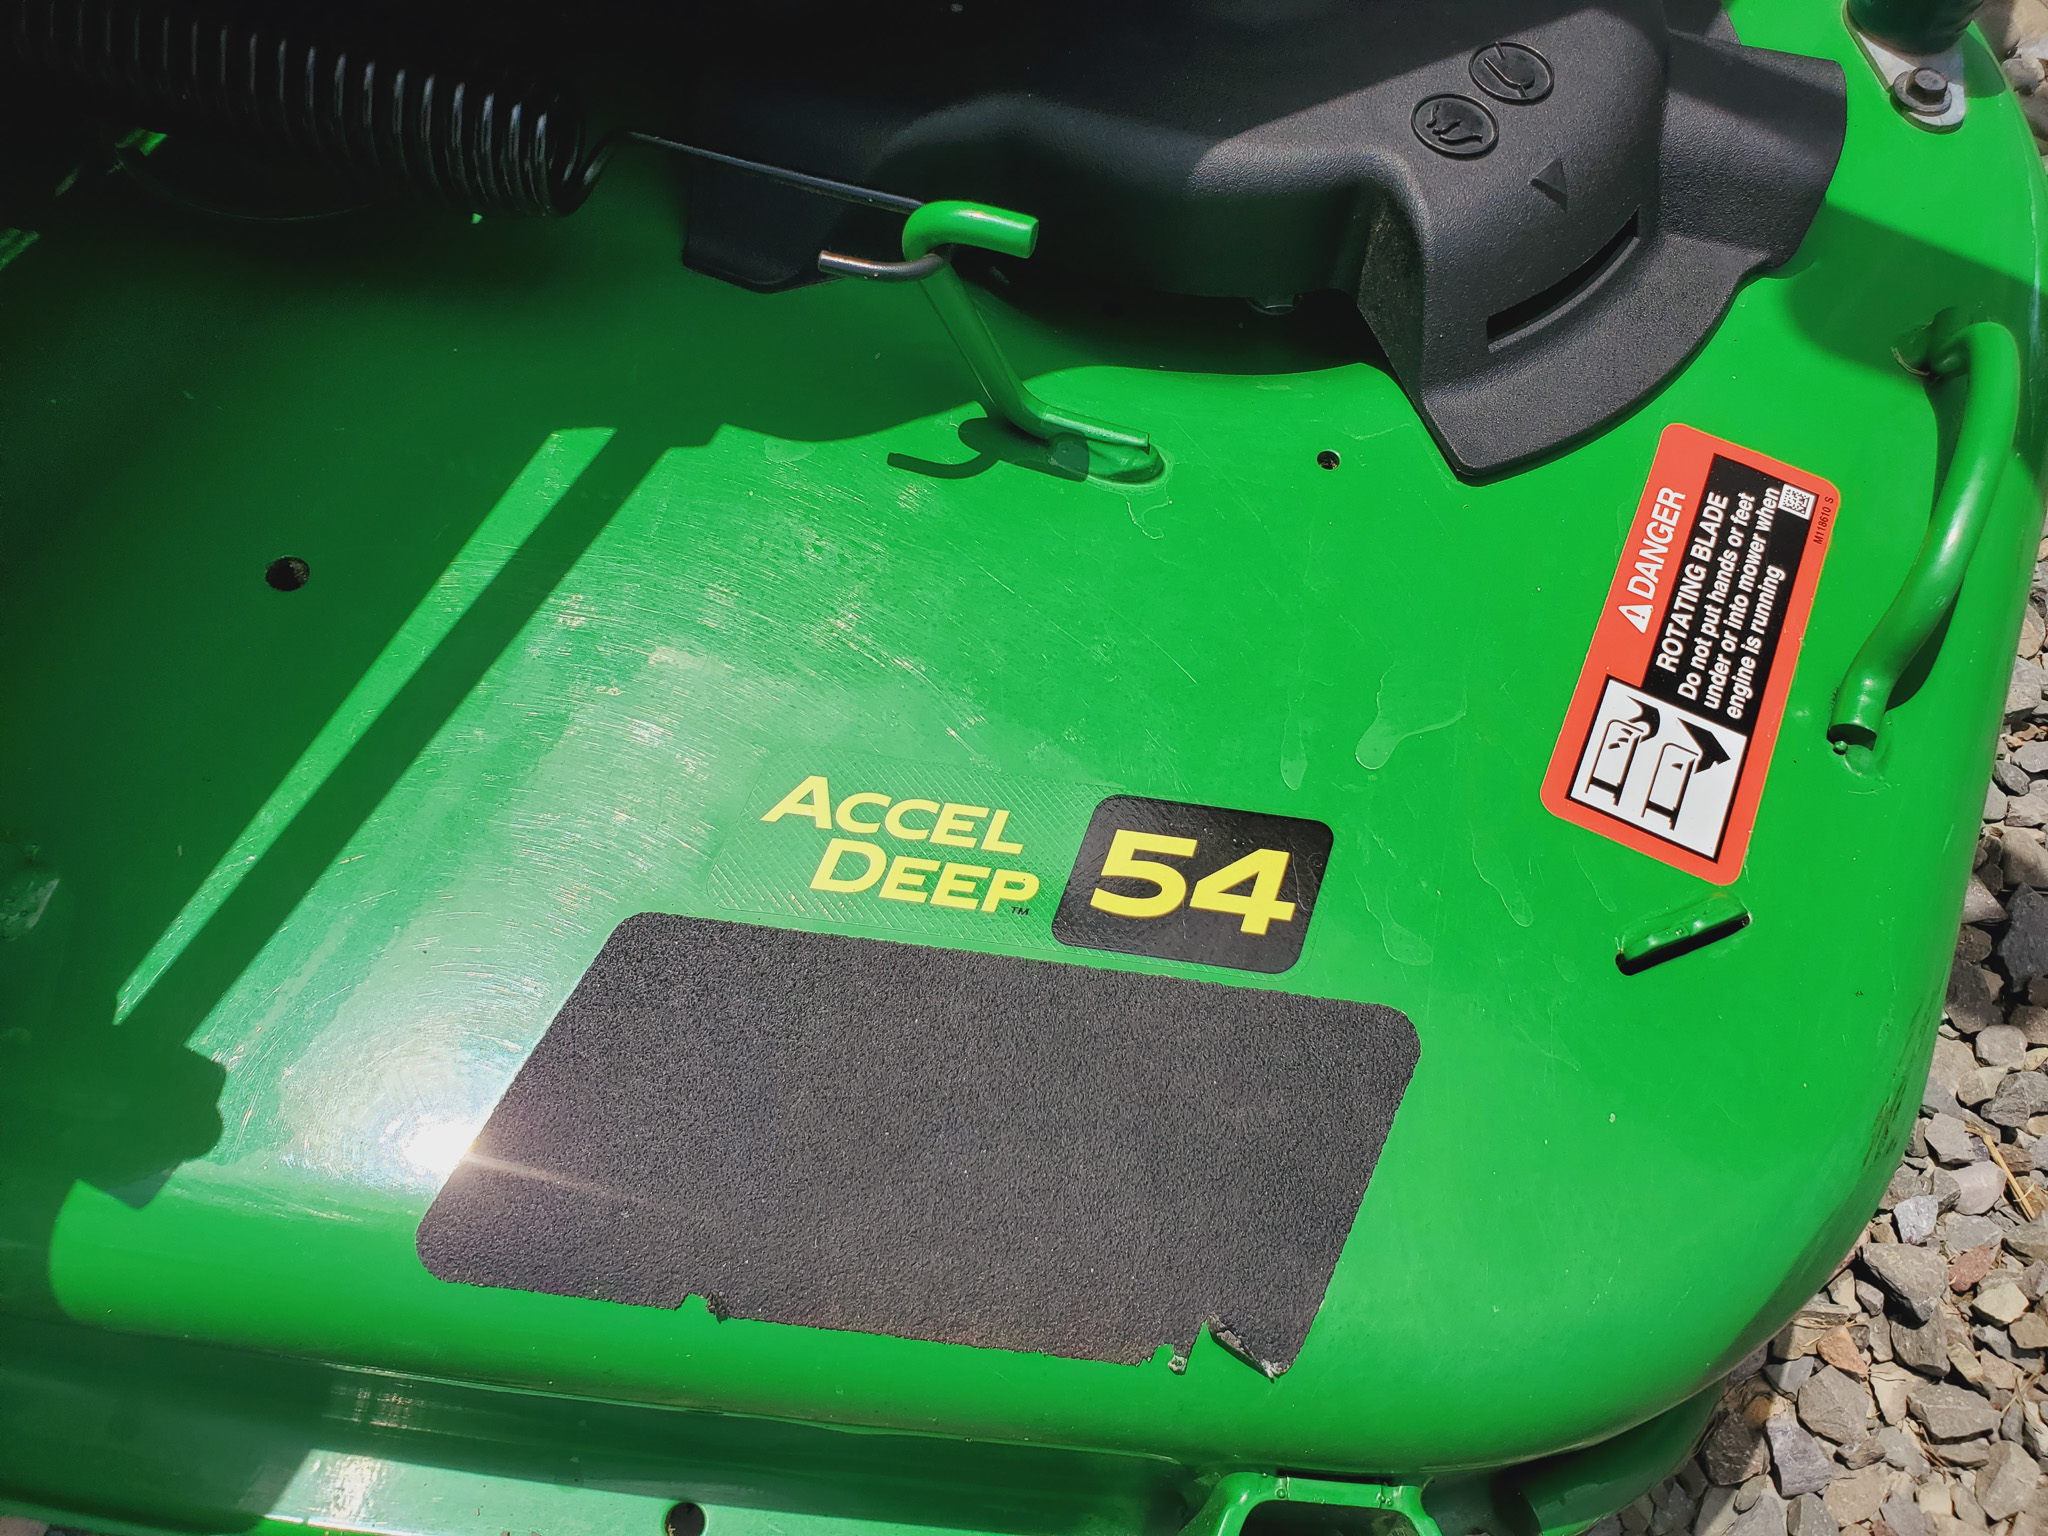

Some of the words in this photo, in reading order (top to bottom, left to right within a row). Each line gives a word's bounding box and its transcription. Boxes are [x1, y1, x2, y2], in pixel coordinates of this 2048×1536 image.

[1730, 491, 1756, 527] feet
[1755, 487, 1781, 533] when
[1813, 506, 1831, 545] M118610
[1824, 496, 1834, 504] S
[1626, 486, 1686, 600] DANGER
[1727, 526, 1745, 549] or
[1655, 563, 1706, 673] ROTATING
[1690, 491, 1729, 562] BLADE
[1713, 549, 1739, 604] hands
[1738, 533, 1768, 594] mower
[1700, 603, 1723, 639] put
[1723, 593, 1749, 630] into
[1750, 564, 1786, 635] running
[1690, 637, 1712, 672] not
[1720, 629, 1739, 653] or
[1740, 635, 1761, 655] is
[1677, 673, 1701, 701] Do
[1704, 653, 1732, 710] under
[1726, 655, 1757, 720] engine
[760, 775, 1024, 855] ACCEL
[1090, 829, 1296, 935] 54
